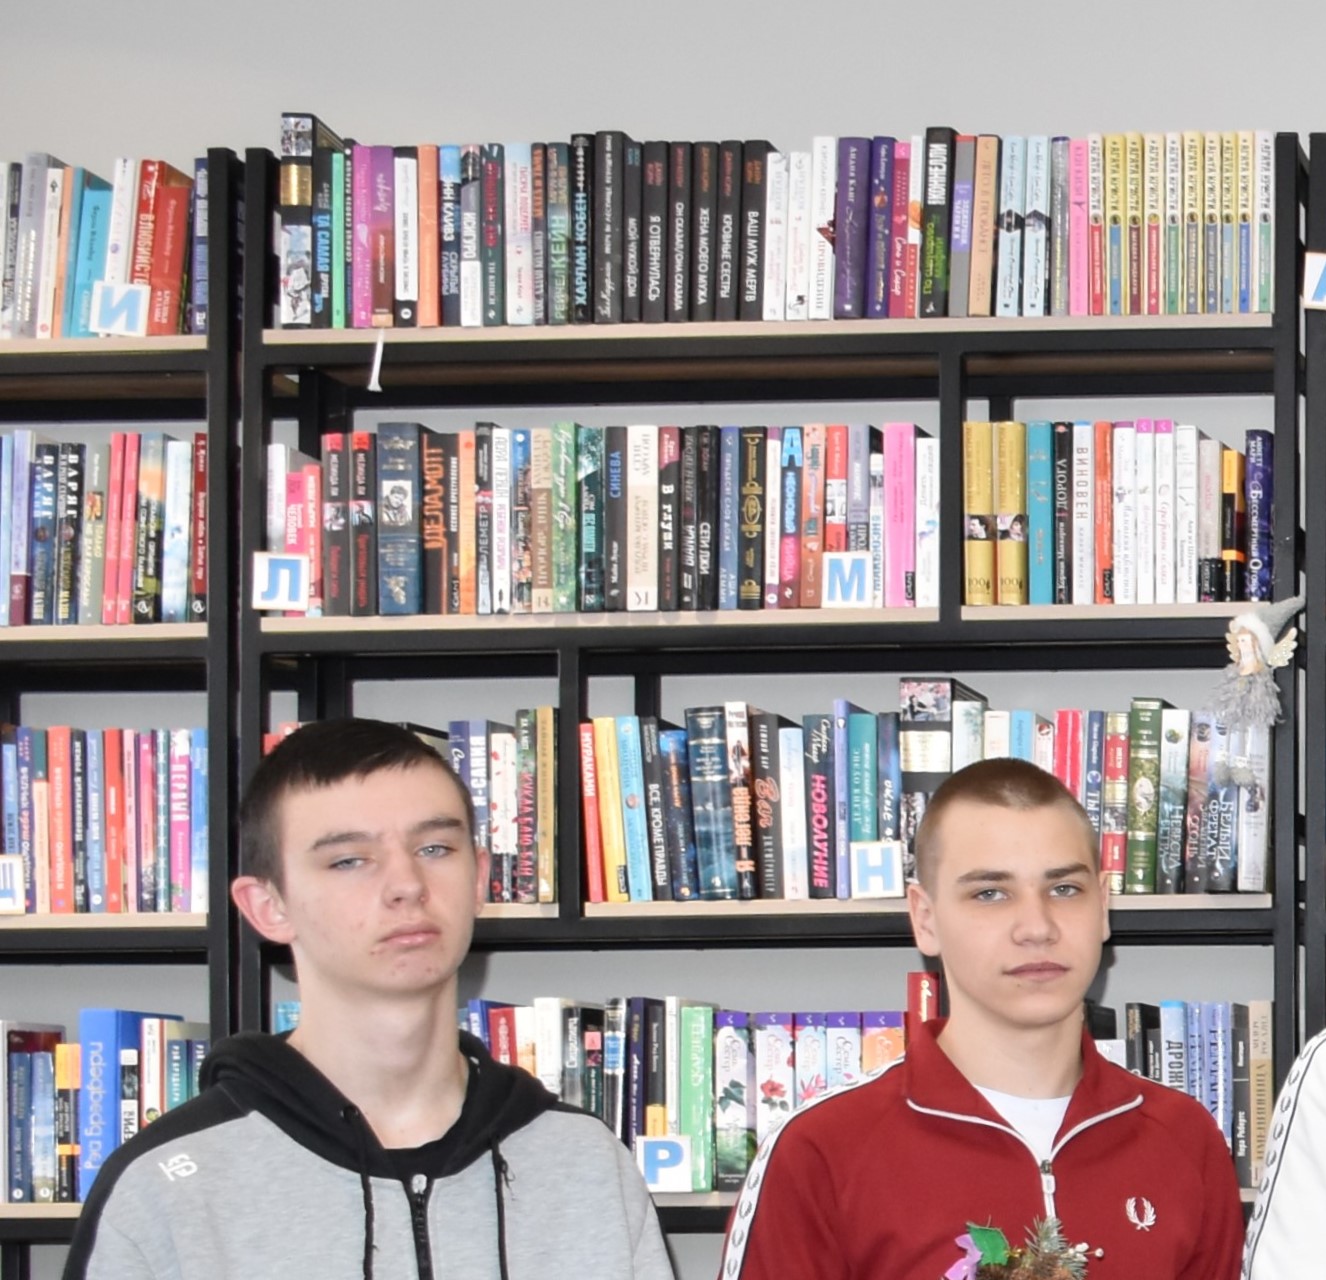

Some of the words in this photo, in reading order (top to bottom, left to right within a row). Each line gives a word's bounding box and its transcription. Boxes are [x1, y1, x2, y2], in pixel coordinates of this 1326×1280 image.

[575, 193, 587, 241] КОБЕН
[699, 208, 710, 234] ЖЕНА
[721, 214, 732, 259] КРОВНЫЕ
[747, 211, 759, 236] ВАШ
[648, 225, 661, 301] ОТВЕРНУЛАСЬ
[698, 236, 709, 272] МОЕГО
[746, 239, 758, 266] МУЖ
[575, 246, 588, 305] ХАРЛАН
[697, 274, 708, 305] МУЖА
[720, 261, 731, 298] СЕСТРЫ
[745, 268, 757, 302] МЕРТВ
[97, 288, 145, 333] И
[43, 455, 54, 519] ВАРЯГ
[68, 454, 79, 518] ВАРЯГ
[610, 451, 622, 498] СИНЕВА
[1076, 447, 1089, 519] ВИНОВЕН
[287, 503, 298, 544] ЧЕЛОВЕК
[700, 522, 710, 548] СЕТИ
[260, 562, 301, 602] Л
[700, 549, 710, 575] ЛЖИ
[829, 559, 866, 601] М
[582, 732, 596, 797] МУРАКАМИ
[648, 784, 660, 809] ВСЕ,
[649, 812, 664, 843] КРОМЕ
[811, 774, 829, 888] НОВОЛУНИЕ
[1217, 800, 1234, 860] БЕЛЫЙ
[653, 845, 668, 886] ПРАВДЫ
[858, 846, 896, 891] Н
[644, 1140, 684, 1184] Р
